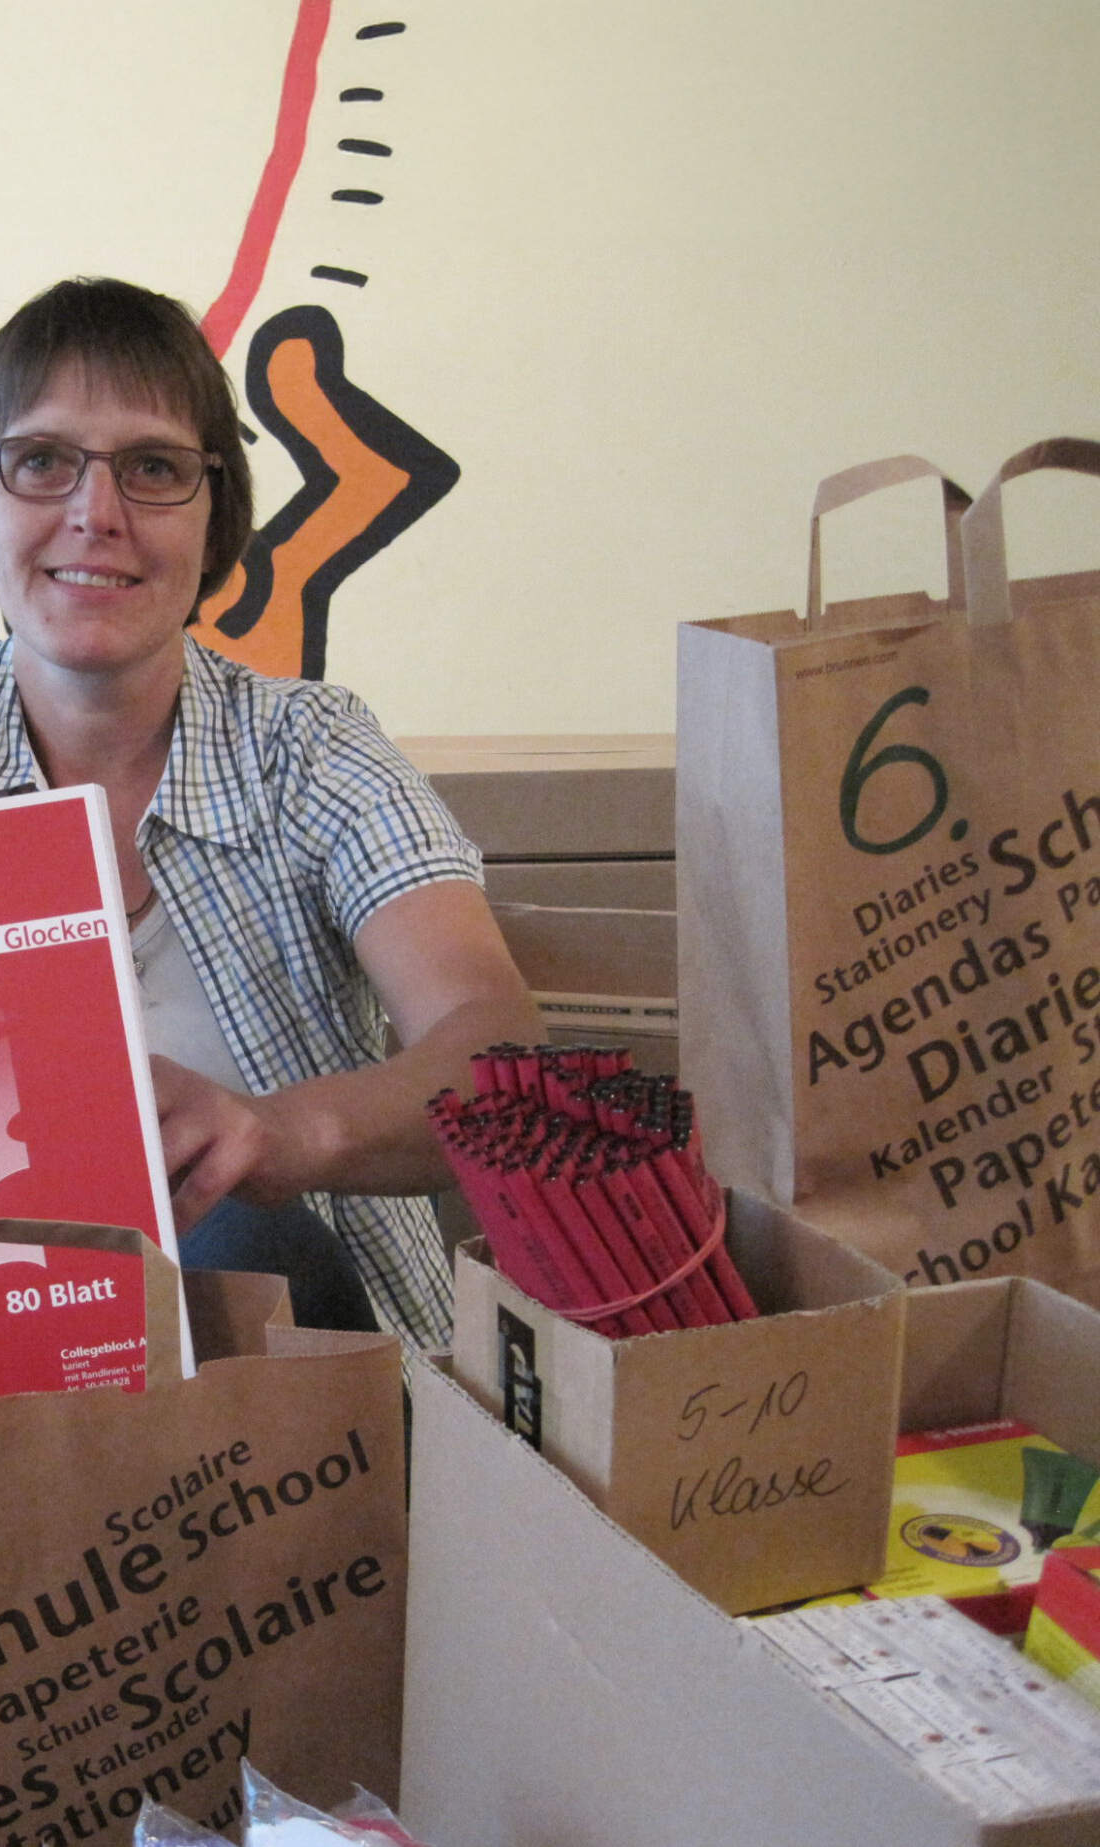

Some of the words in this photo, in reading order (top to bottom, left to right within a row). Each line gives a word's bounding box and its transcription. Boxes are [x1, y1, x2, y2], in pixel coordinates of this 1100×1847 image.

[839, 685, 969, 855] 6.
[3, 916, 109, 951] Glocken
[853, 852, 980, 937] Diaries
[815, 888, 990, 1005] Stationery
[807, 921, 1050, 1086] Agendas
[869, 1064, 1053, 1180] Kalender
[903, 1198, 1035, 1287] hool
[6, 1287, 41, 1314] 80
[49, 1277, 117, 1308] Blatt
[60, 1338, 136, 1359] Collegeblock
[62, 1360, 90, 1371] kariert
[65, 1374, 79, 1382] mit
[105, 1440, 252, 1546] Scolaire
[179, 1430, 371, 1562] School
[671, 1457, 852, 1530] Klasse
[119, 1554, 386, 1732] Scolaire
[17, 1701, 119, 1761] Schule
[73, 1694, 211, 1786] Kalender
